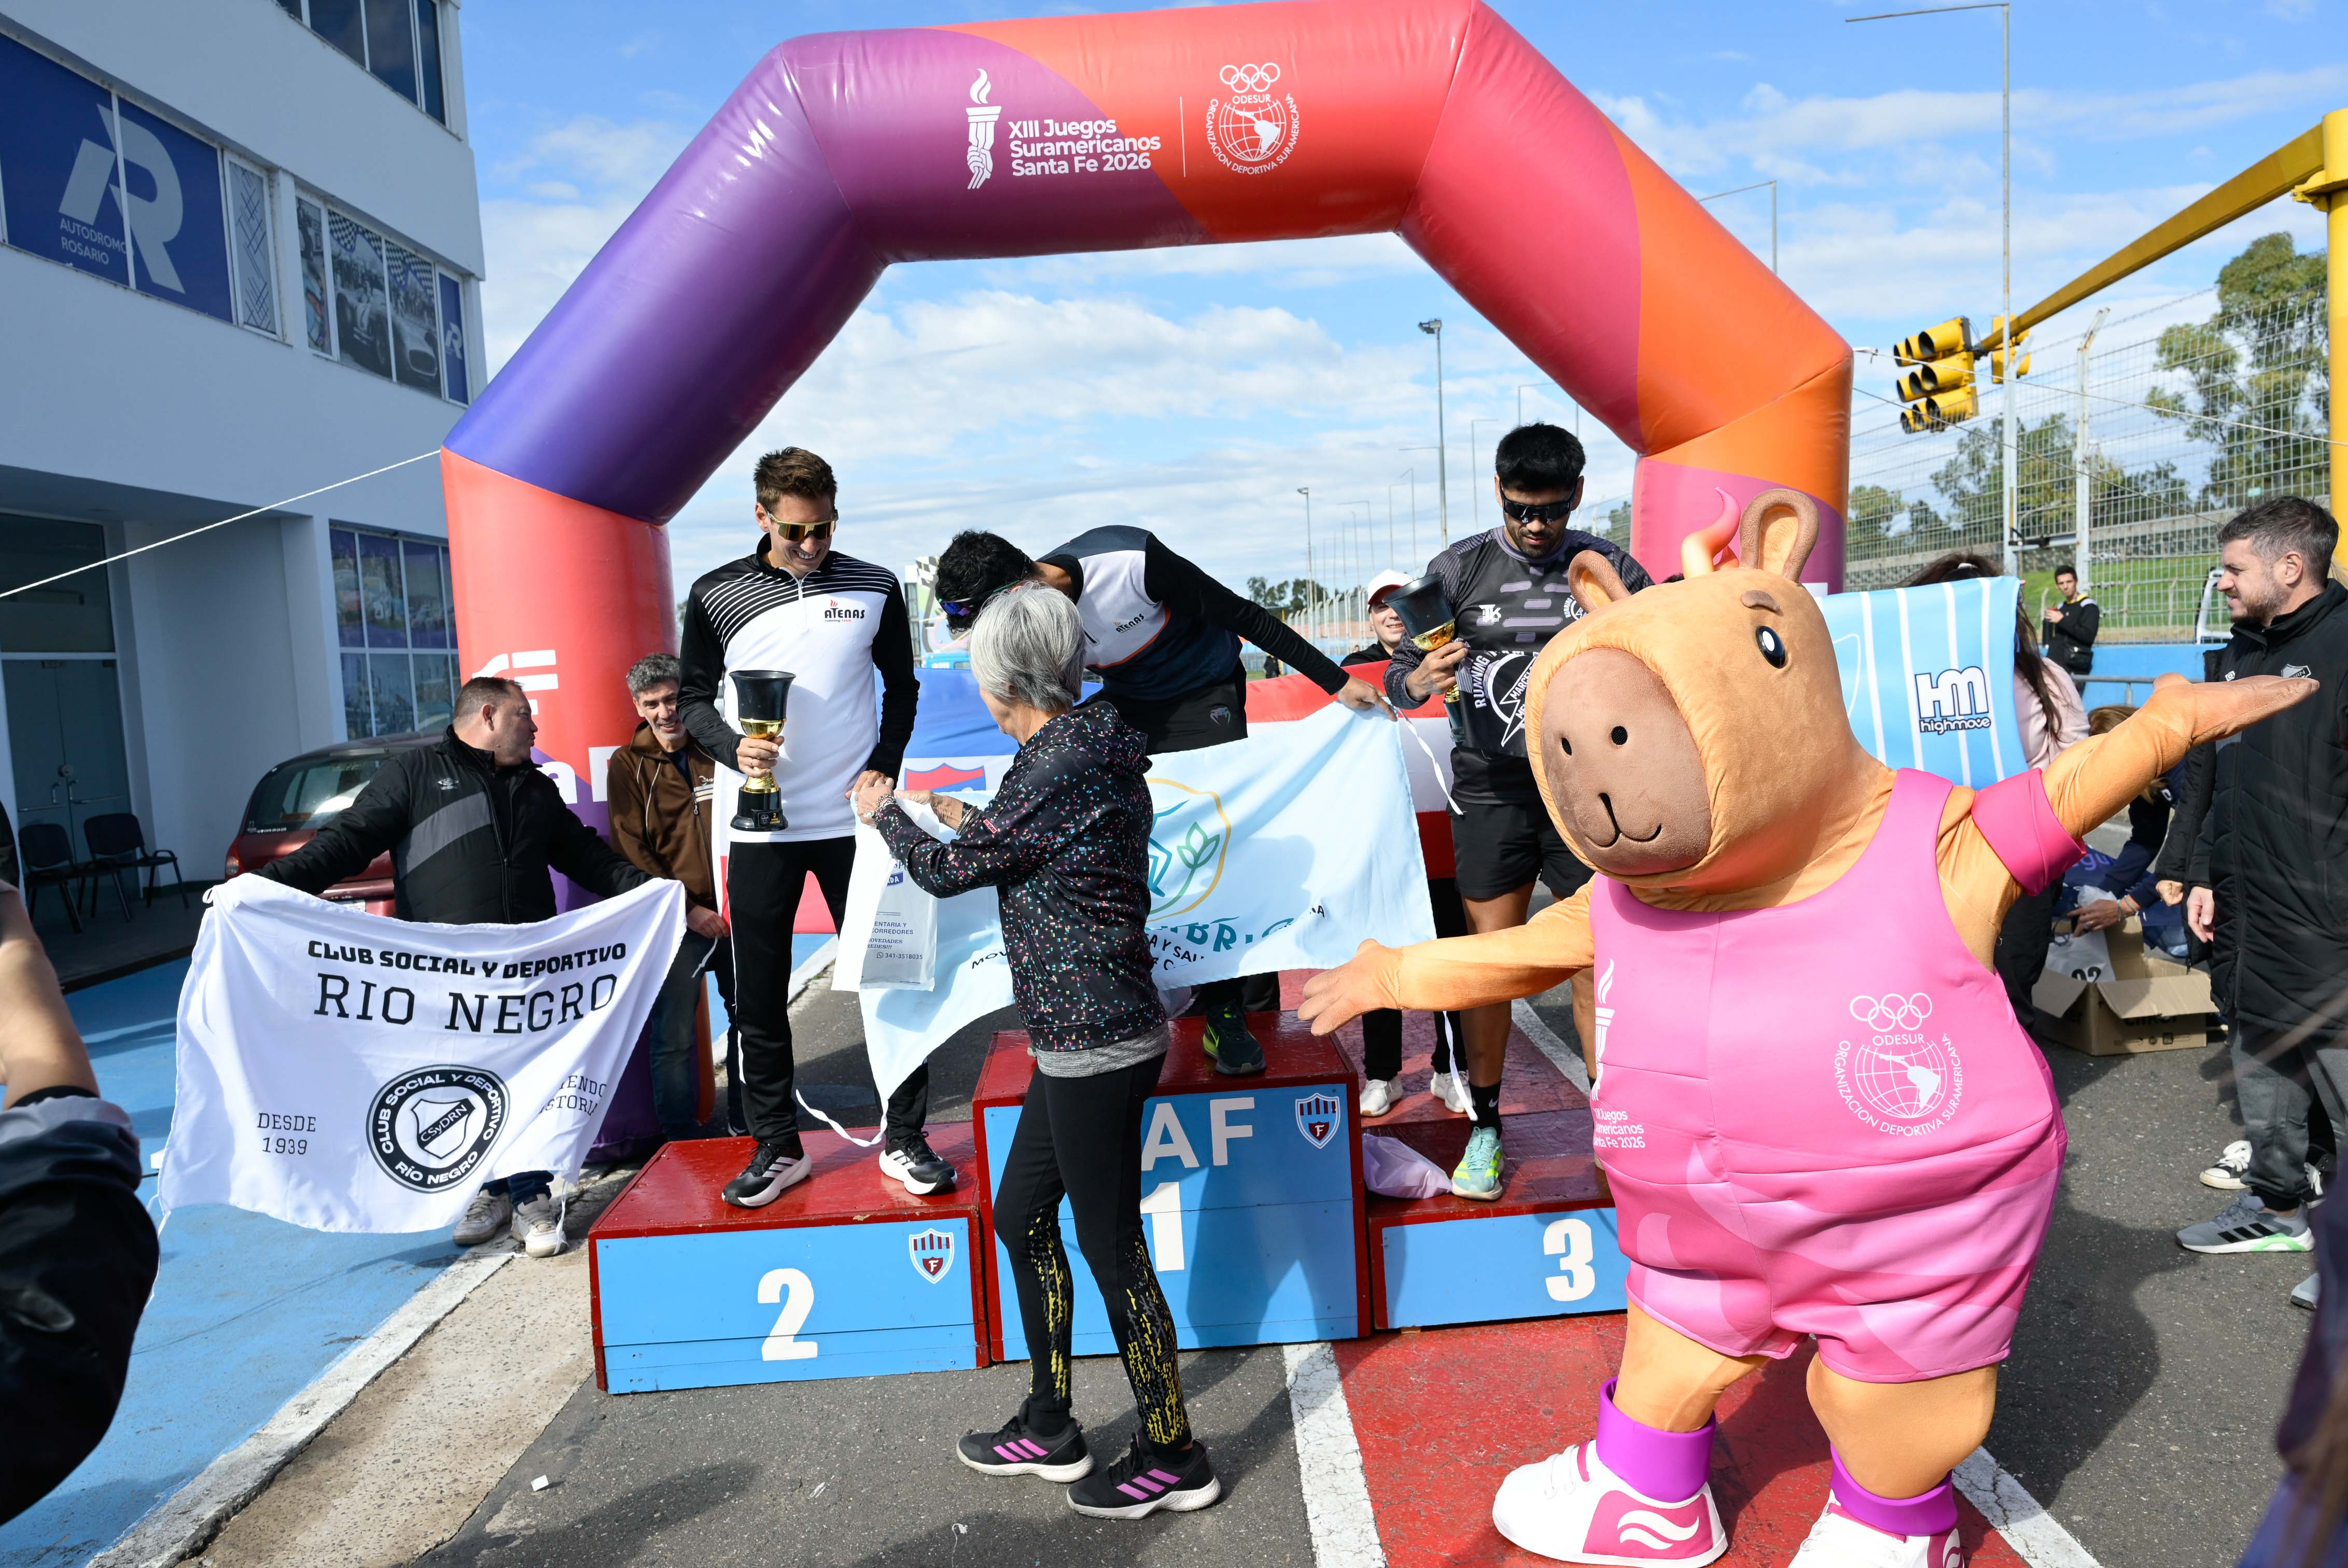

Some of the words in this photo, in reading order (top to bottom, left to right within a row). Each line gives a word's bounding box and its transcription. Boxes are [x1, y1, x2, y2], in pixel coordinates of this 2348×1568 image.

[1232, 94, 1270, 104] ODESUR
[1008, 120, 1039, 138] XIII
[1043, 119, 1116, 139] Juegos
[1206, 99, 1232, 167] ORGANIZACION
[1232, 161, 1278, 175] DEPORTIVA
[1276, 93, 1299, 164] SURAMERICANA
[1010, 134, 1161, 158] Suramericanos
[1012, 159, 1069, 176] Santa
[1074, 156, 1098, 173] Fe
[1101, 152, 1151, 171] 2026
[61, 236, 109, 265] ROSARIO
[824, 608, 865, 619] ATENAS
[1115, 613, 1144, 633] ATENAS
[1471, 654, 1491, 709] RUNNING
[1919, 717, 1992, 736] highmove
[308, 940, 374, 964] CLUB
[380, 950, 476, 975] SOCIAL
[481, 962, 498, 978] Y
[502, 943, 626, 979] DEPORTIVO
[314, 972, 415, 1026] RIO
[444, 974, 617, 1034] NEGRO
[1872, 1033, 1925, 1046] ODESUR
[385, 1074, 445, 1106] SOCIAL
[451, 1073, 463, 1082] Y
[1834, 1040, 1879, 1128] ORGANIZACION
[1879, 1118, 1945, 1137] DEPORTIVA
[1941, 1032, 1963, 1121] SURAMERICANA
[464, 1075, 502, 1141] DEPORTIVO
[1600, 1109, 1628, 1124] Juegos
[257, 1113, 316, 1132] DESDE
[378, 1108, 394, 1154] CLUB
[421, 1104, 468, 1142] CSyDRN
[1595, 1120, 1644, 1135] americanos
[262, 1137, 308, 1155] 1939
[1605, 1137, 1619, 1148] Fe
[1618, 1136, 1646, 1148] 2026
[427, 1151, 478, 1185] NEGRO
[1140, 1182, 1185, 1271] 1
[1543, 1219, 1595, 1301] 3
[758, 1268, 818, 1361] 2
